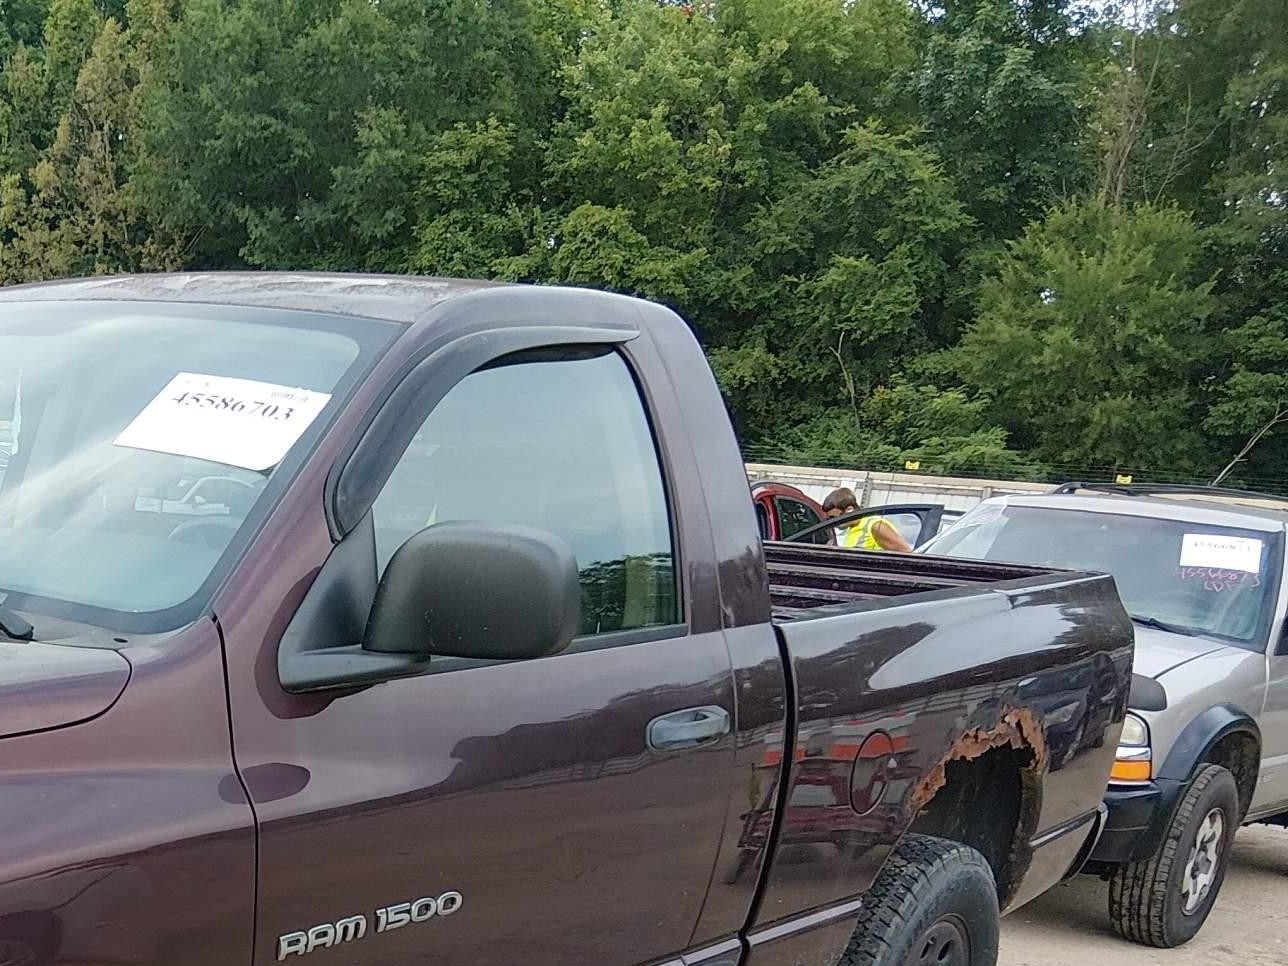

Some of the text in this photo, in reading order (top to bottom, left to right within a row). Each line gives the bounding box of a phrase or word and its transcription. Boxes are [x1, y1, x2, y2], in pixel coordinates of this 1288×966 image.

[172, 392, 294, 420] 45586703
[277, 890, 463, 961] RAM 1500
